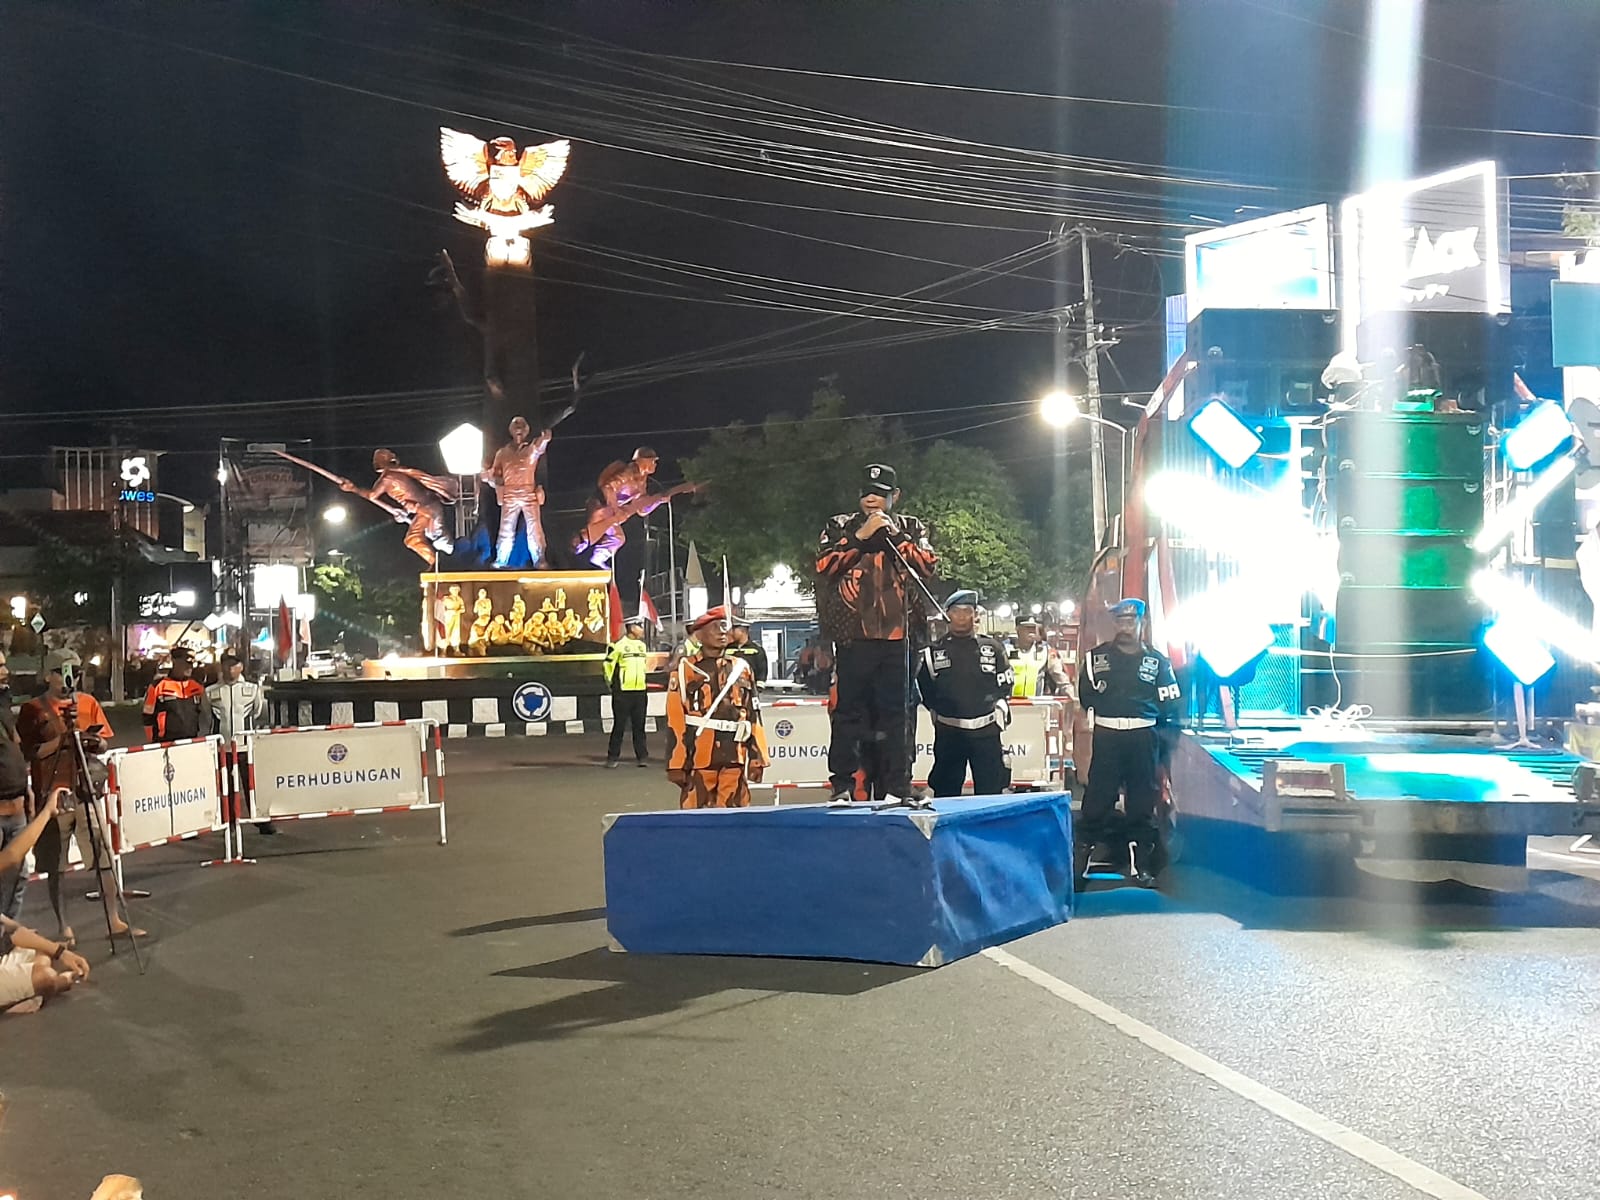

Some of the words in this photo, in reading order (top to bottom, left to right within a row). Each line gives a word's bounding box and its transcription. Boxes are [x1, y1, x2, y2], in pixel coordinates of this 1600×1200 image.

[1158, 683, 1181, 702] PA
[276, 767, 401, 789] PERHUBUNGAN
[134, 787, 206, 814] PERHUBUNGAN
